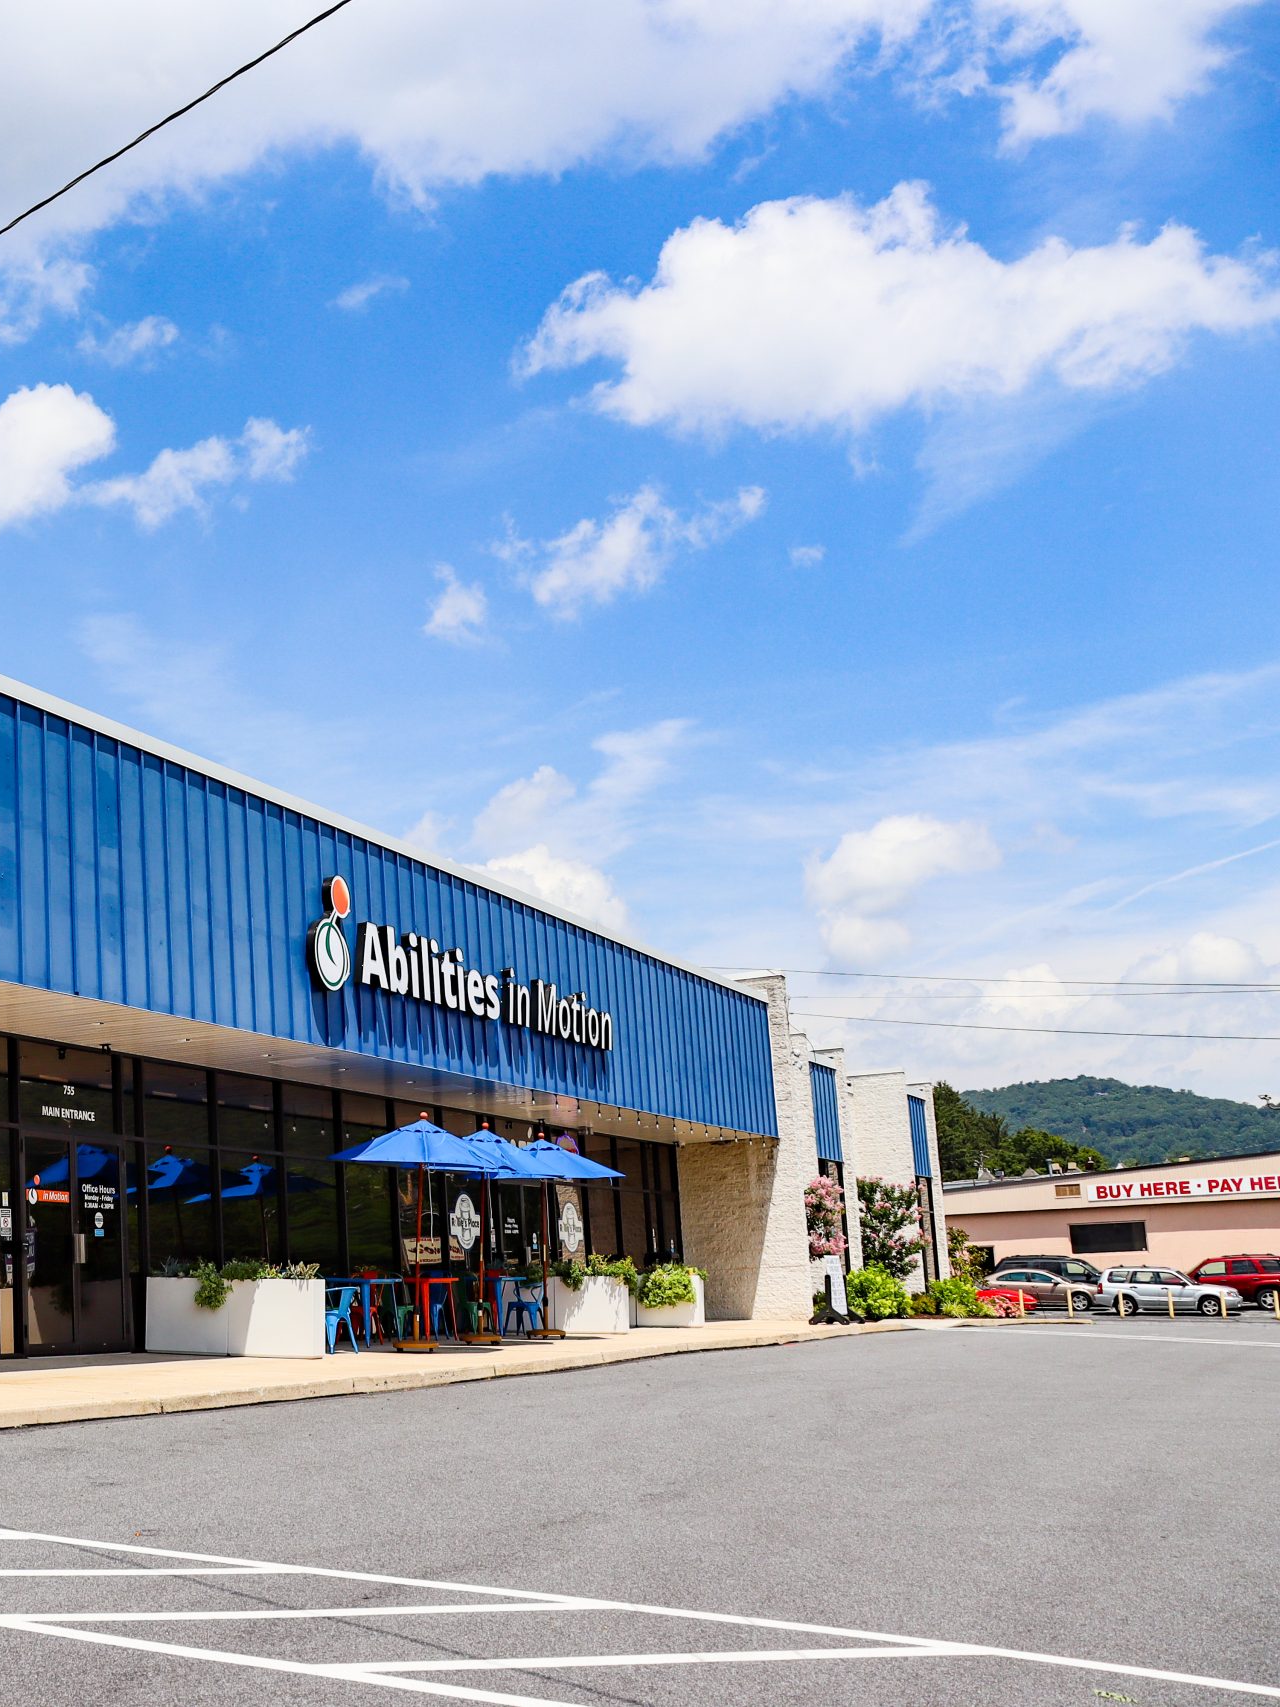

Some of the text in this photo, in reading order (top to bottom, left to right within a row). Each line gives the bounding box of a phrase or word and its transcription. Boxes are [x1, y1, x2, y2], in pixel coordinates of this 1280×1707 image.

[358, 921, 613, 1051] Abilities in Motion
[63, 1085, 75, 1096] 755
[41, 1105, 95, 1122] MAIN ENTRANCE
[81, 1183, 116, 1195] Office Hours
[1096, 1184, 1134, 1200] BUY
[1140, 1181, 1191, 1197] HERE
[1207, 1178, 1244, 1193] PAY
[1250, 1175, 1280, 1191] HE
[49, 1191, 68, 1202] Motion
